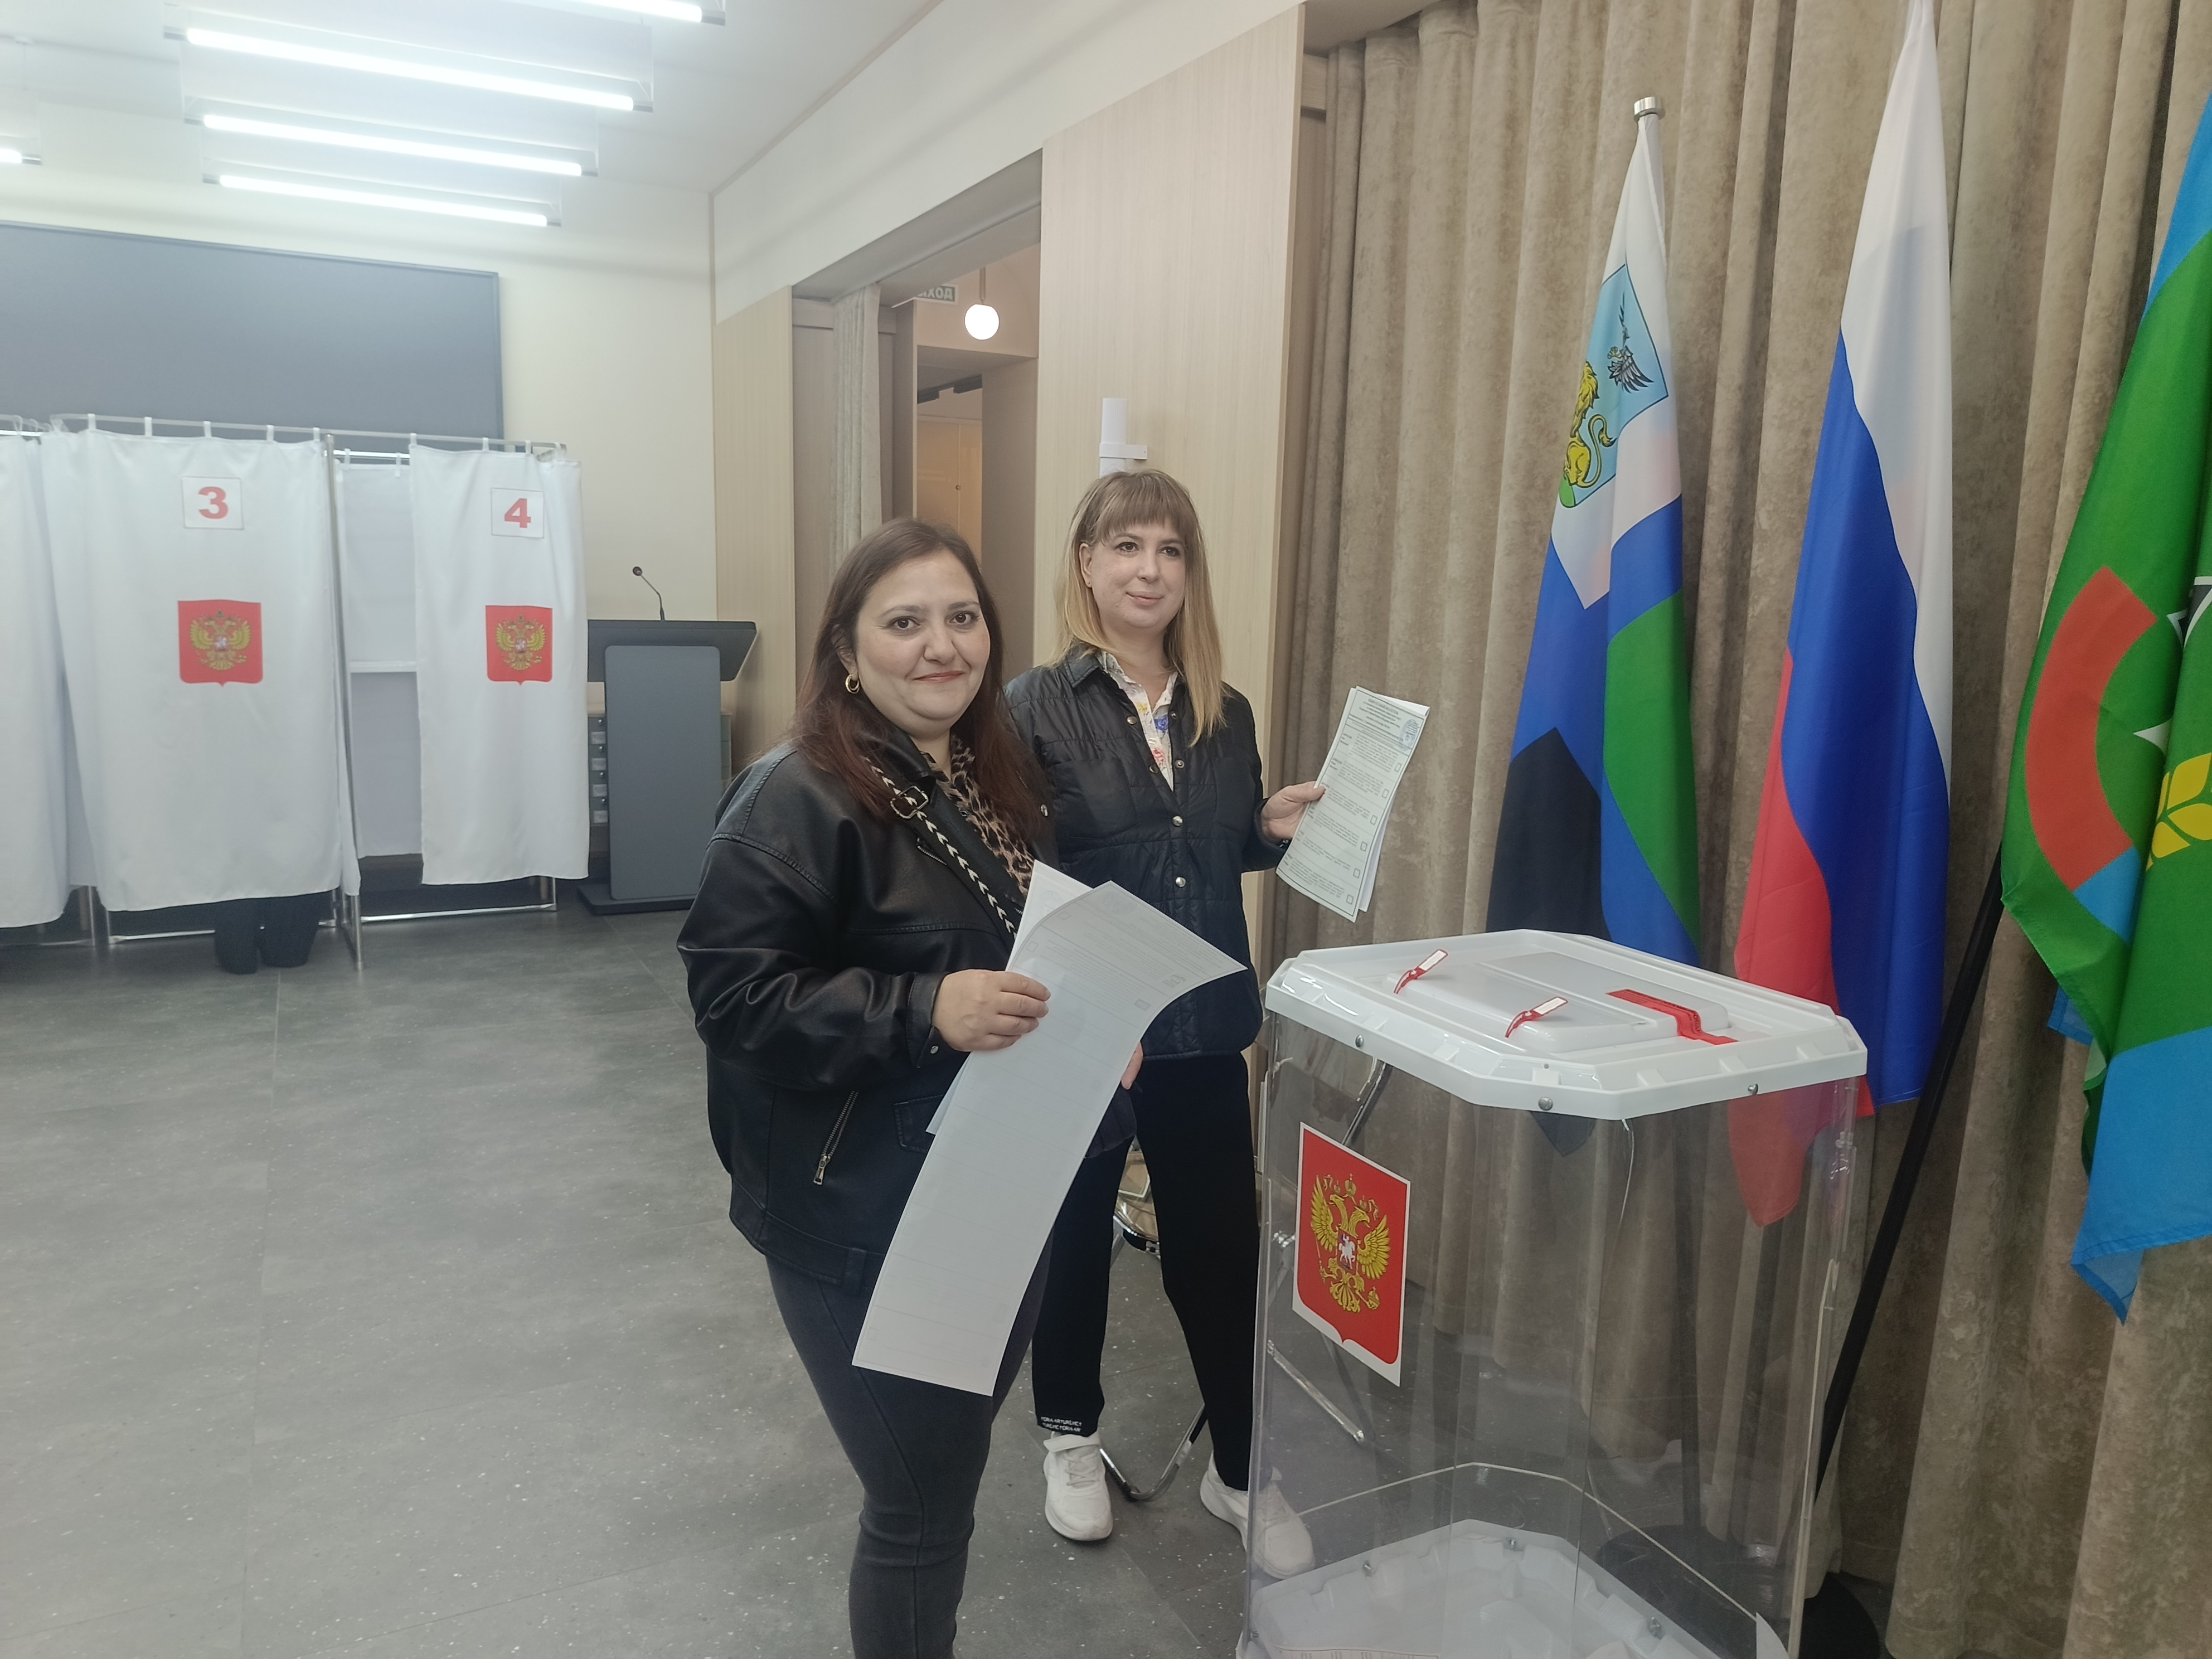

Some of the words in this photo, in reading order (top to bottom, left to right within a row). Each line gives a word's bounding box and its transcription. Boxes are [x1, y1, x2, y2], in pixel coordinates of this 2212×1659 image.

[918, 287, 953, 300] ХОД
[198, 486, 229, 520] 3
[504, 498, 531, 528] 4
